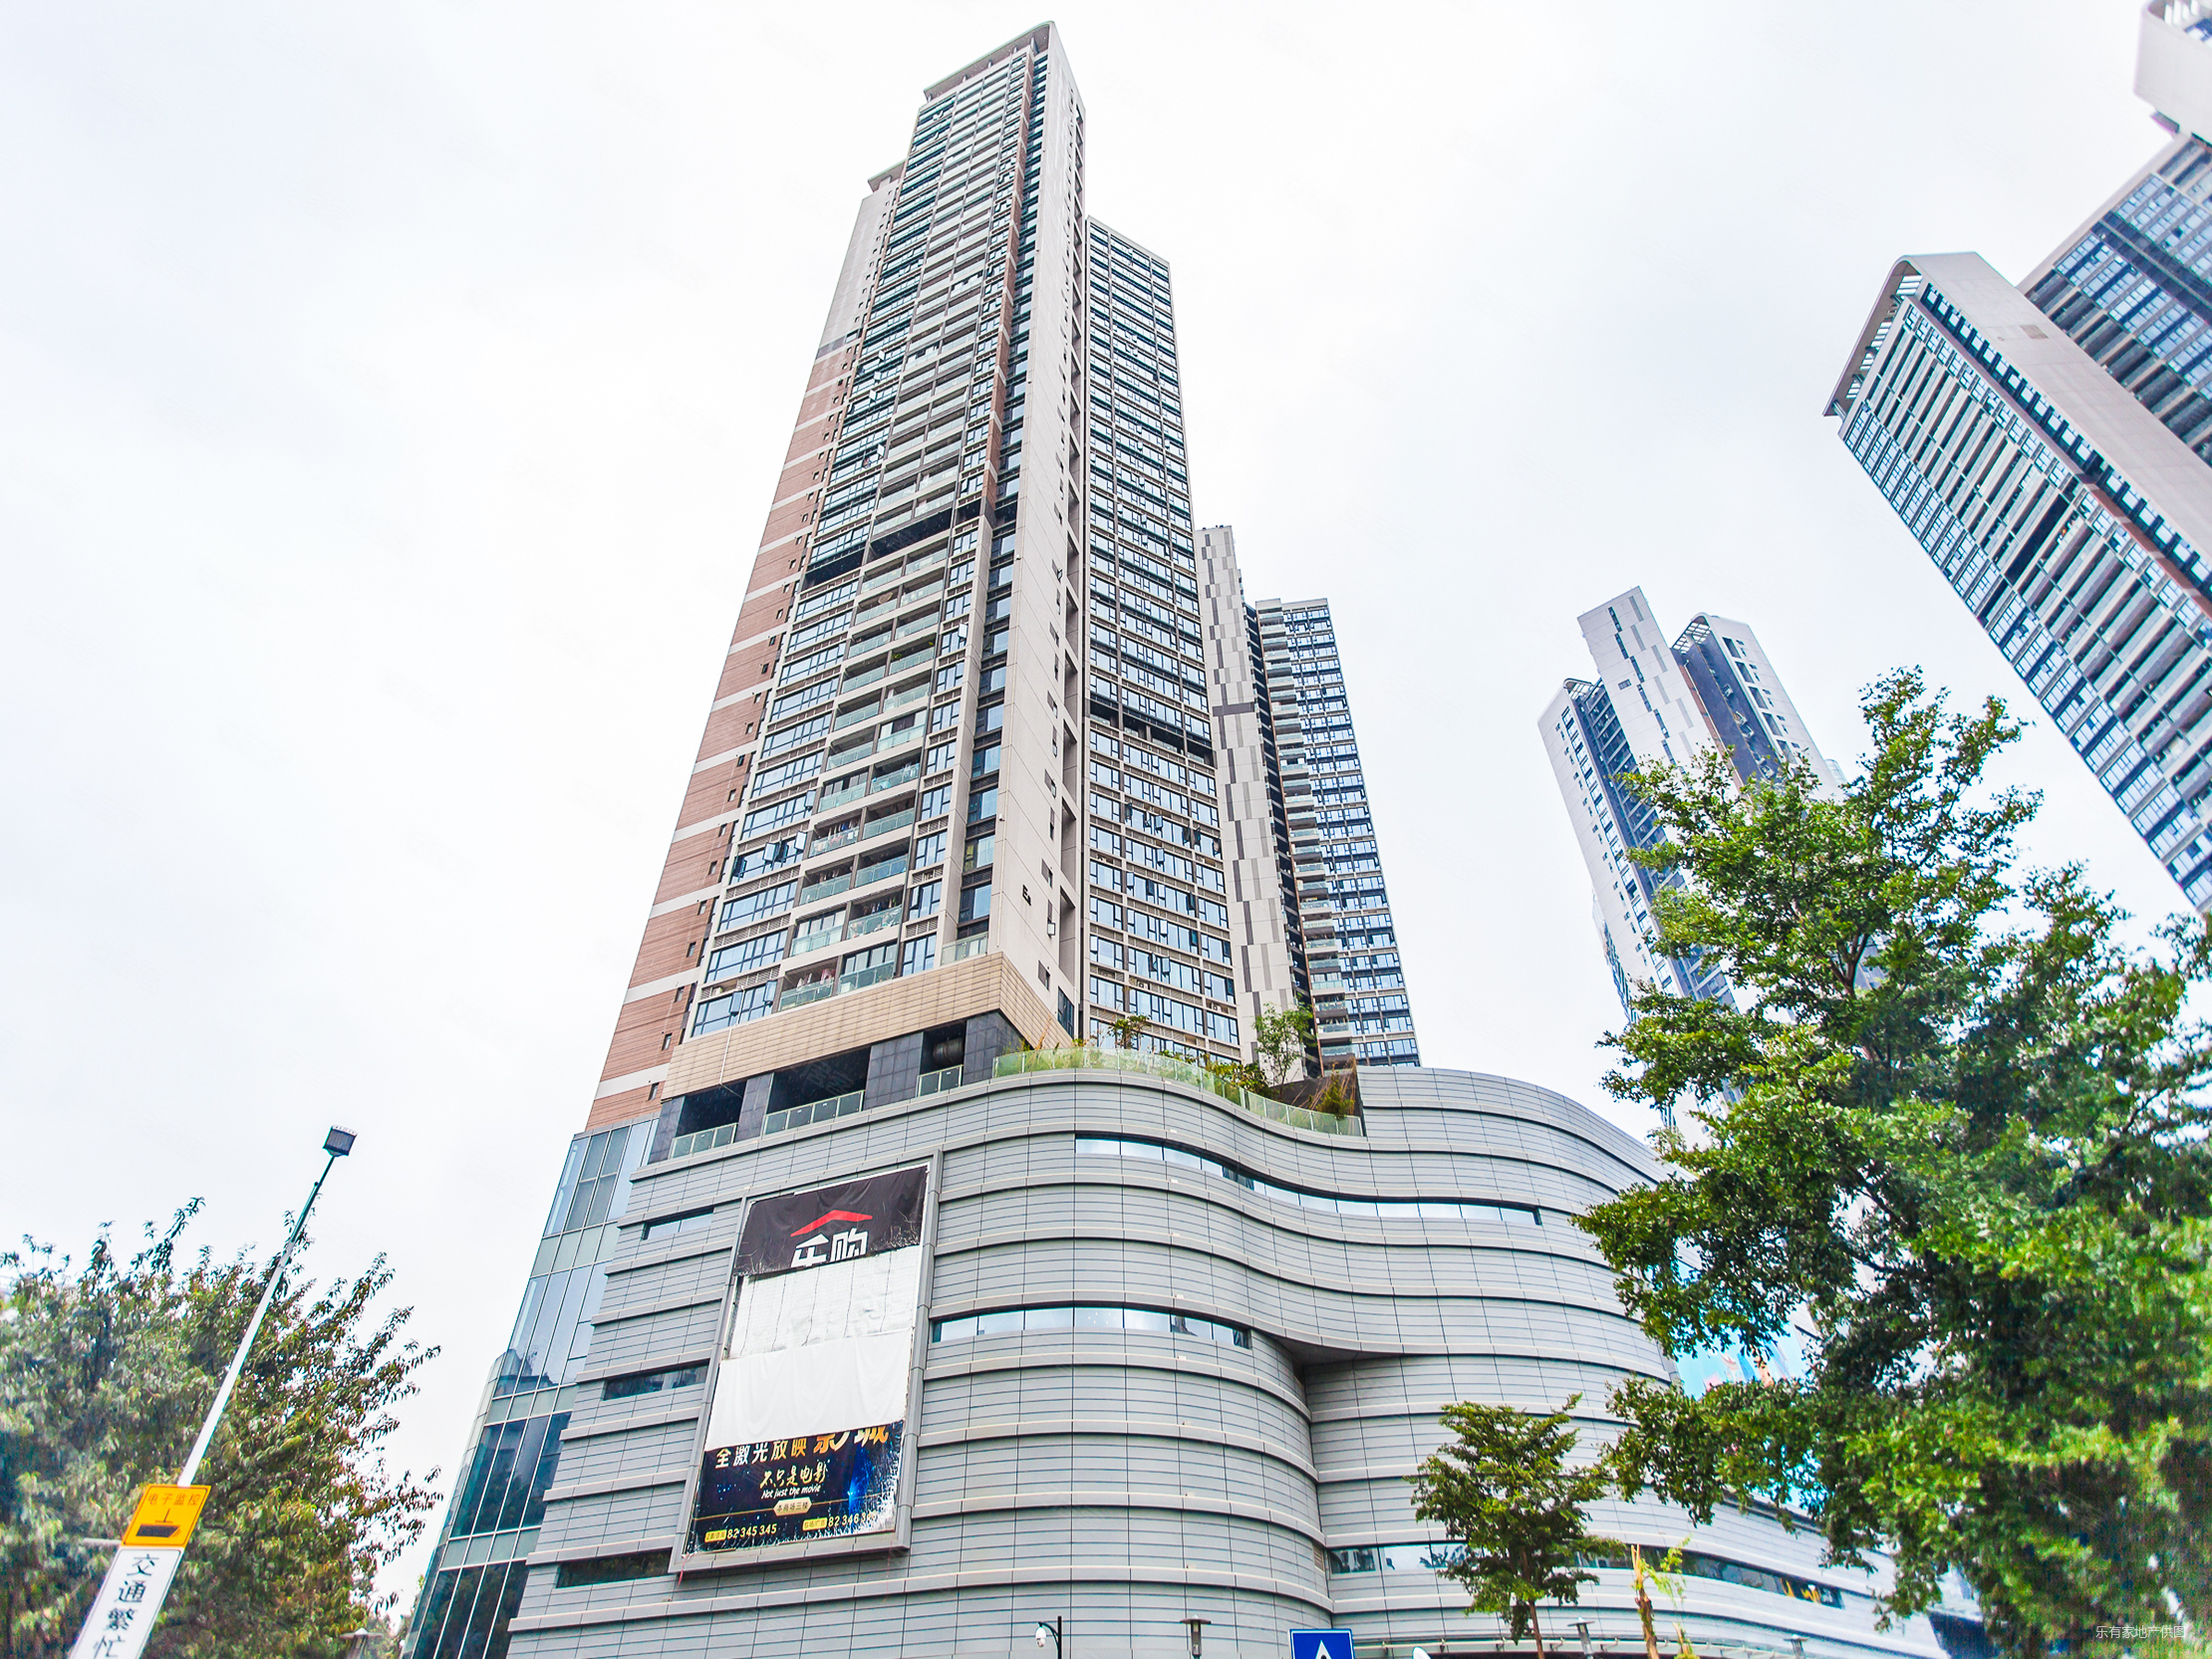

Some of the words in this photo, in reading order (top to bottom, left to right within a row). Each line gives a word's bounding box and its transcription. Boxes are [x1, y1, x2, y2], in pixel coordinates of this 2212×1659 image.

[714, 1438, 807, 1470] 全激光放映
[147, 1493, 201, 1507] 电子监控
[760, 1489, 774, 1500] Not
[773, 1488, 788, 1500] just
[788, 1486, 800, 1496] the
[800, 1484, 822, 1495] movie
[93, 1553, 159, 1659] 交通繁忙
